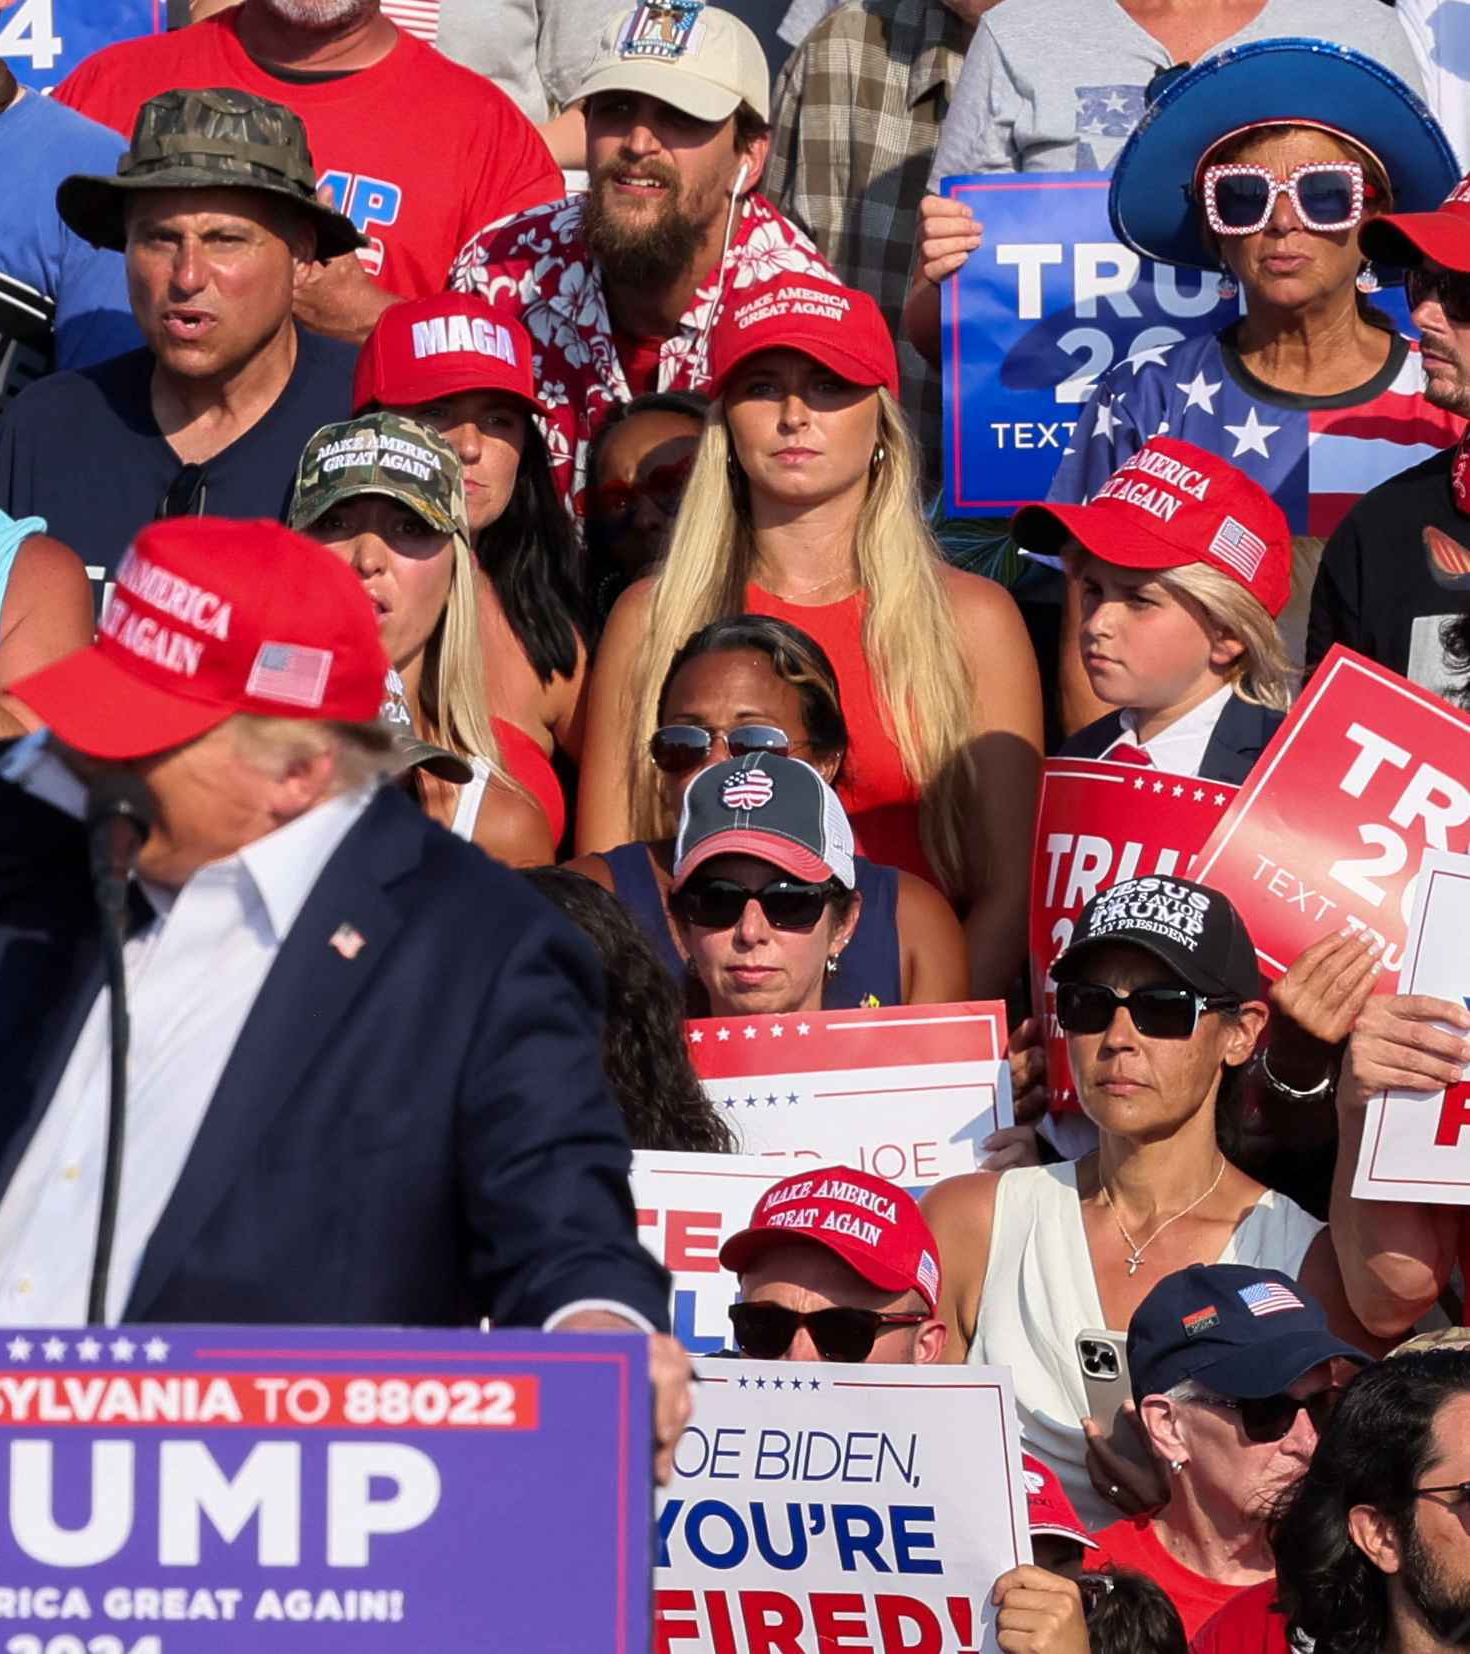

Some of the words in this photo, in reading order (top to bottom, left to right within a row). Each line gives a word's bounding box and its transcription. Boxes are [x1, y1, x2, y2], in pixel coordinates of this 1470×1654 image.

[734, 293, 774, 322] MAKE
[775, 287, 850, 311] AMERICA
[738, 302, 789, 330] GREAT
[790, 302, 842, 322] AGAIN
[412, 315, 517, 368] MAGA
[316, 436, 364, 462] MAKE
[366, 433, 441, 470] AMERICA
[323, 451, 377, 473] GREAT
[380, 453, 430, 481] AGAIN
[1113, 479, 1183, 523] AGAIN
[117, 614, 205, 679] AGAIN
[1096, 877, 1211, 911] JESUS
[1252, 854, 1337, 921] TEXT
[1090, 902, 1205, 936] TRUMP
[1137, 892, 1204, 924] SAVIOR
[1117, 918, 1198, 952] PRESIDENT
[860, 1141, 940, 1180] JOE
[763, 1180, 813, 1212] MAKE
[813, 1180, 897, 1225] AMERICA
[824, 1212, 882, 1247] AGAIN
[254, 1378, 331, 1424] TO
[342, 1379, 517, 1425] 88022
[674, 1426, 746, 1479] OE
[754, 1429, 921, 1489] BIDEN,
[655, 1499, 944, 1575] YOU'RE
[102, 1587, 243, 1621] GREAT
[253, 1588, 405, 1622] AGAIN!
